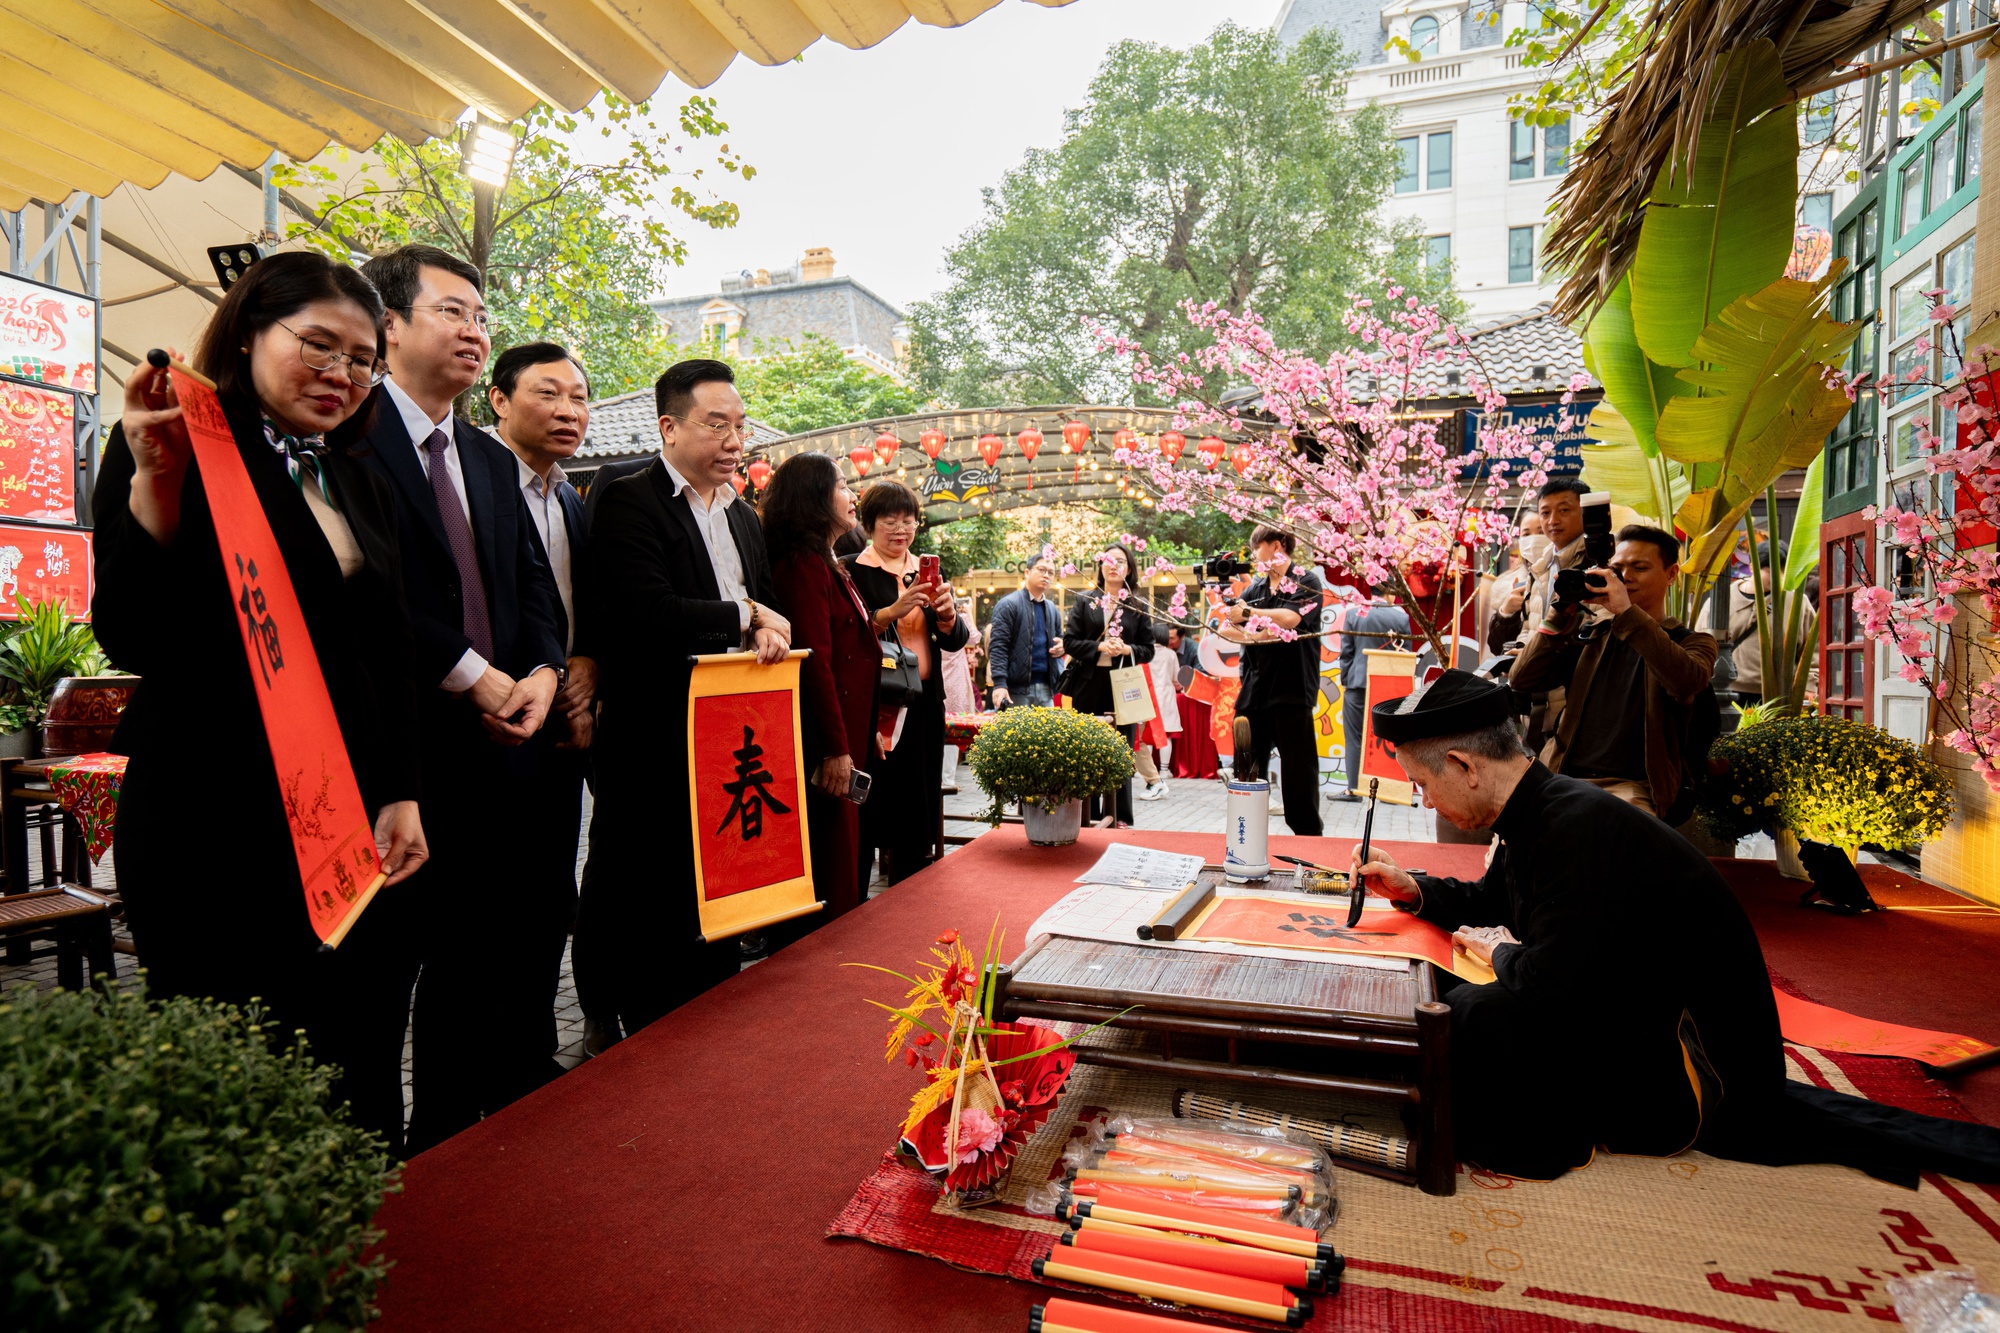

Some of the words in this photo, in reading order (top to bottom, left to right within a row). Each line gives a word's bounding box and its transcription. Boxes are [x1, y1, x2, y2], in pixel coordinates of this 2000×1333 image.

[920, 474, 954, 495] Vườn
[958, 468, 999, 489] Sách
[235, 552, 285, 691] 福
[715, 725, 791, 841] 春
